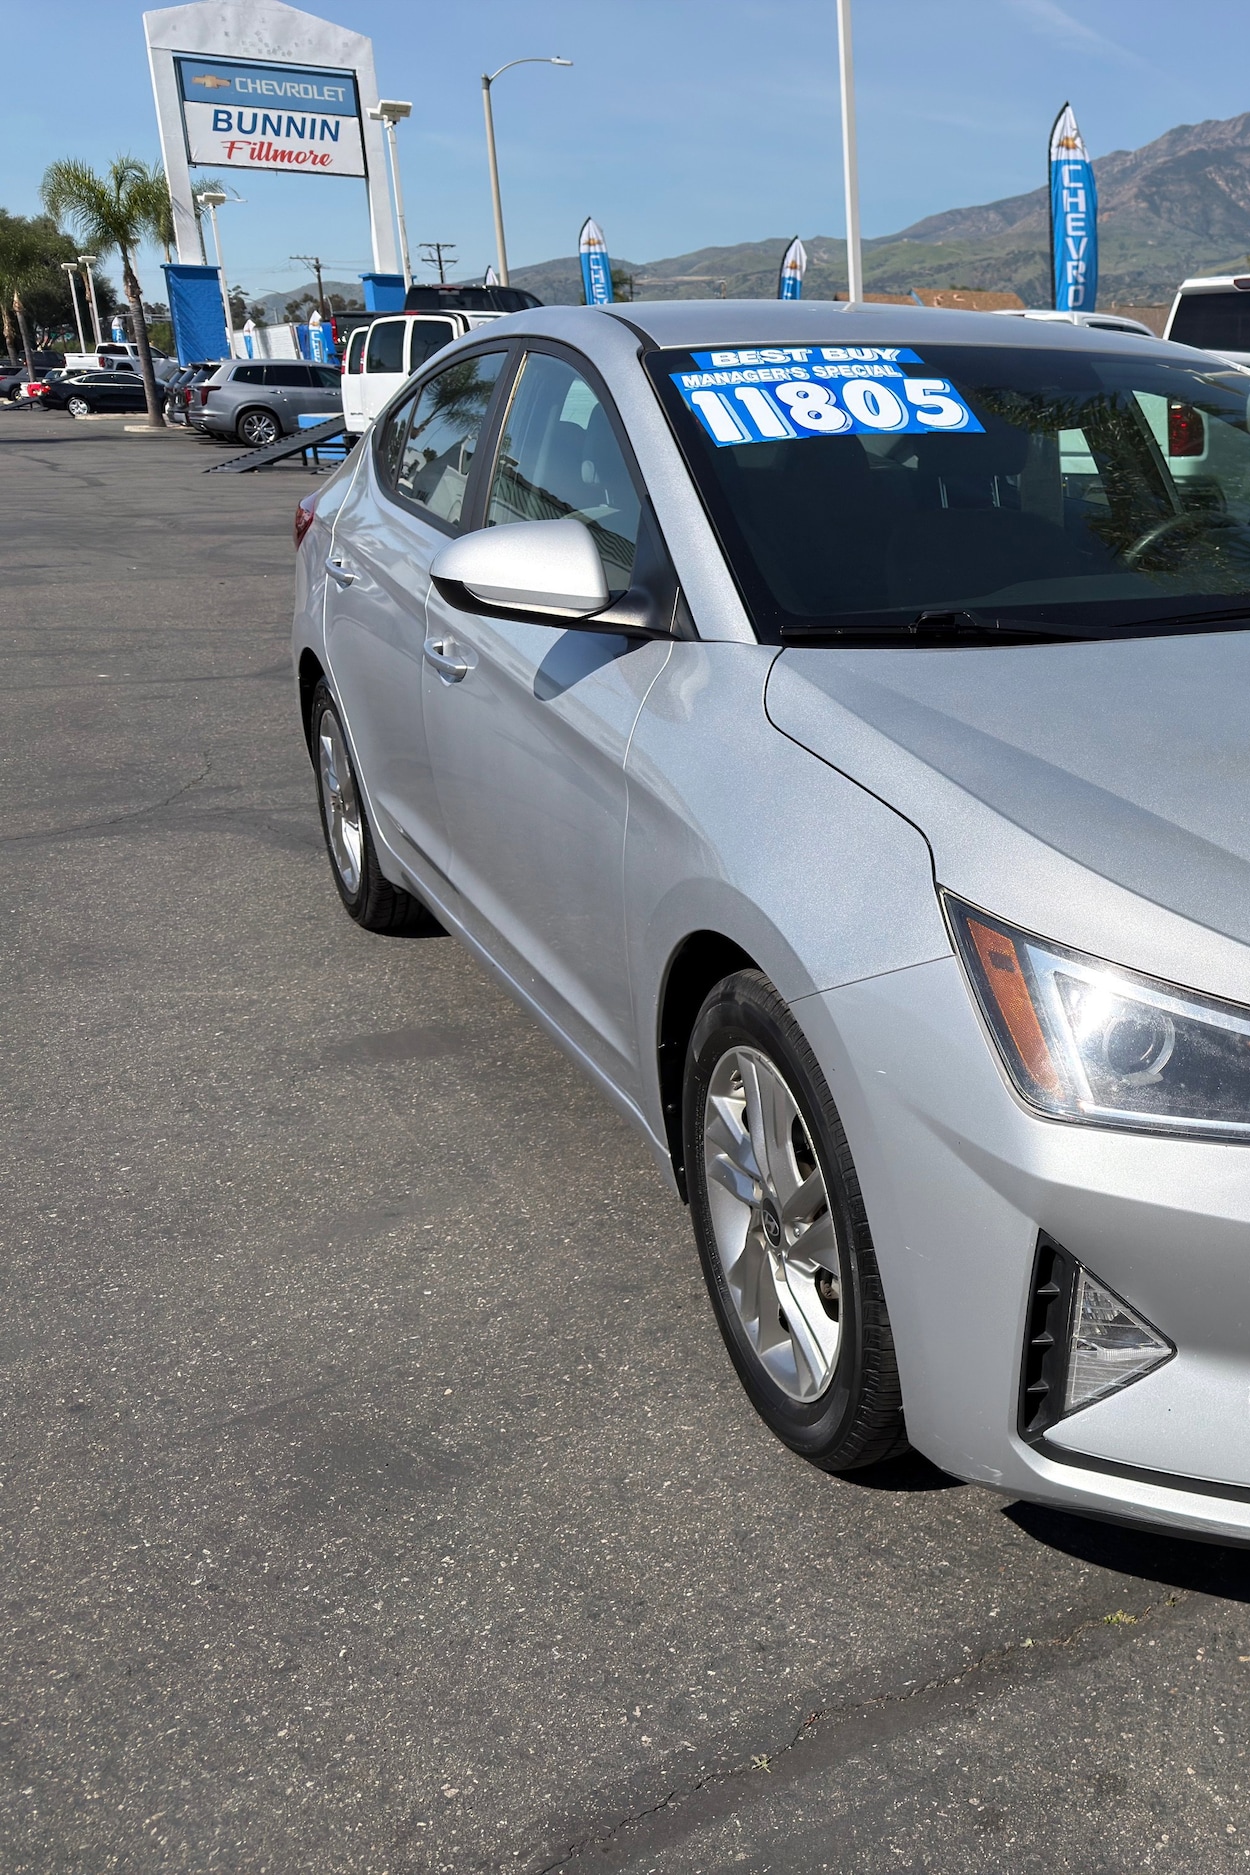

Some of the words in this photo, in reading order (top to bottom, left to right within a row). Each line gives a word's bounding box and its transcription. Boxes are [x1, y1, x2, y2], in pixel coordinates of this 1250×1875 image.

[235, 77, 346, 102] CHEVROLET
[212, 109, 341, 142] BUNNIN
[221, 140, 333, 167] Fillmore
[710, 348, 812, 366] BEST
[820, 347, 901, 362] BUY
[681, 365, 807, 389] MANAGER'S
[814, 364, 903, 380] SPECIAL
[690, 378, 969, 443] 11805
